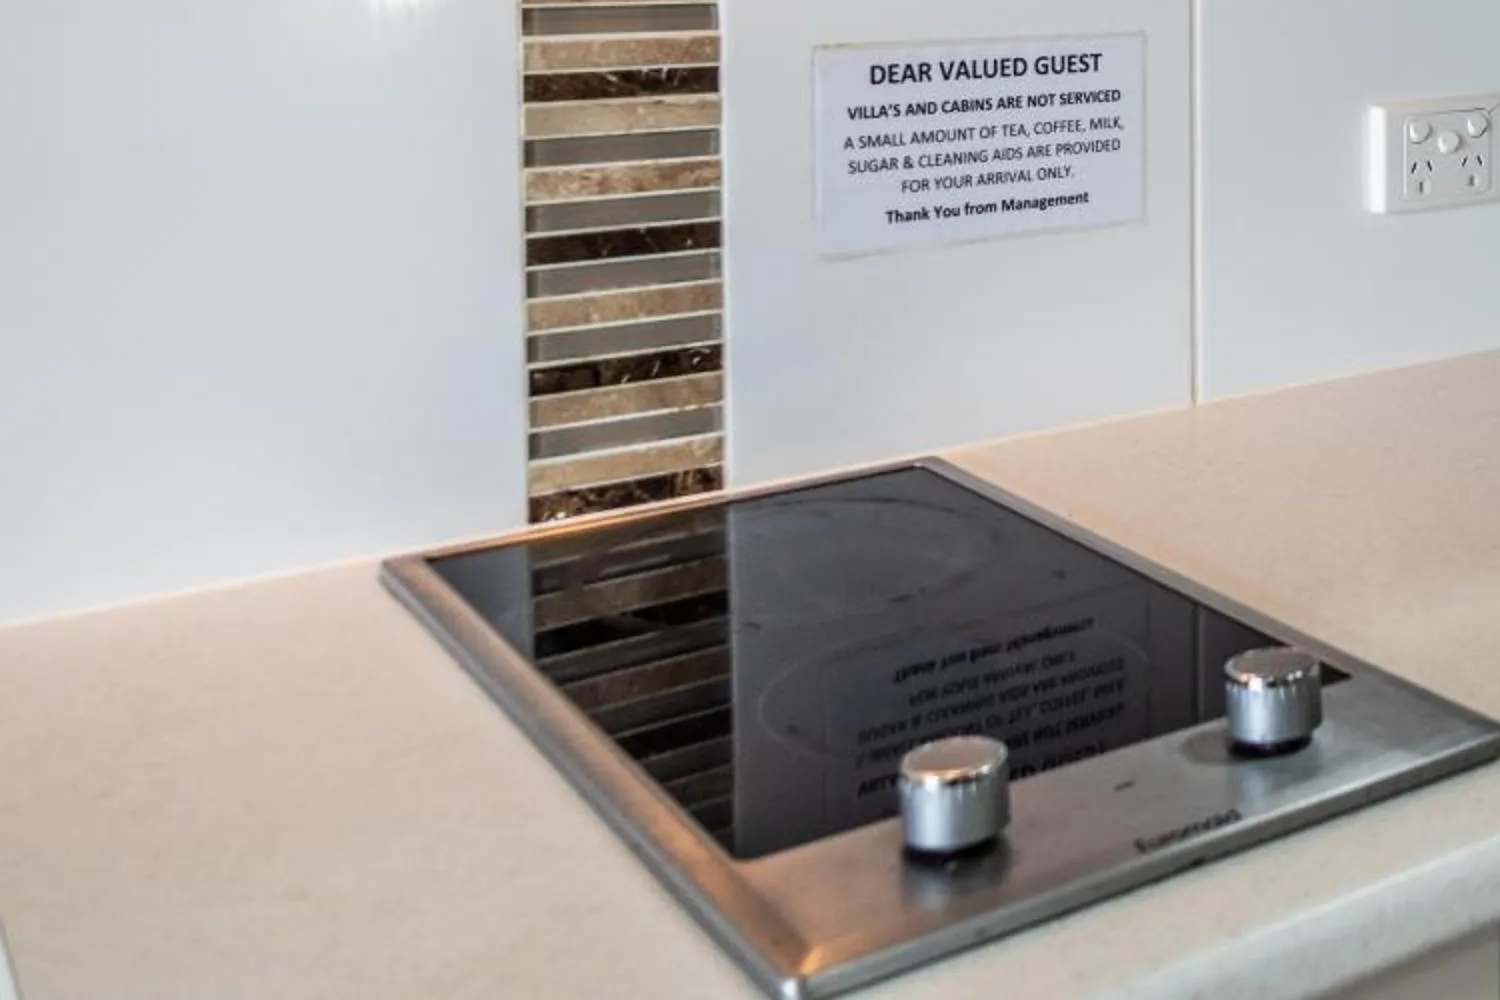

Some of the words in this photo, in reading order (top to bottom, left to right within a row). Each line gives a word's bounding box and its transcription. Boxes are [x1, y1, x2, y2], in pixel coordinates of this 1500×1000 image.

[869, 62, 932, 86] DEAR
[938, 57, 1028, 82] VALUED
[1034, 53, 1103, 76] GUEST
[847, 103, 902, 120] VILLA'S
[905, 101, 938, 116] AND
[941, 97, 993, 114] CABINS
[996, 95, 1023, 110] ARE
[1027, 92, 1057, 108] NOT
[1059, 88, 1121, 106] SERVICED
[843, 135, 855, 150] A
[858, 131, 907, 149] SMALL
[910, 127, 976, 145] AMOUNT
[979, 125, 998, 140] OF
[1002, 123, 1031, 138] TEA,
[1033, 119, 1087, 136] COFFEE,
[847, 157, 899, 175] SUGAR
[902, 155, 915, 169] &
[918, 149, 989, 169] CLEANING
[992, 146, 1023, 161] AIDS
[1027, 143, 1053, 158] ARE
[1055, 138, 1121, 156] PROVIDED
[901, 178, 930, 194] FOR
[933, 175, 973, 190] YOUR
[976, 169, 1032, 186] ARRIVAL
[1036, 164, 1075, 181] ONLY.
[885, 205, 931, 225] Thank
[934, 204, 961, 219] You
[963, 201, 998, 217] from
[1001, 191, 1089, 211] Management
